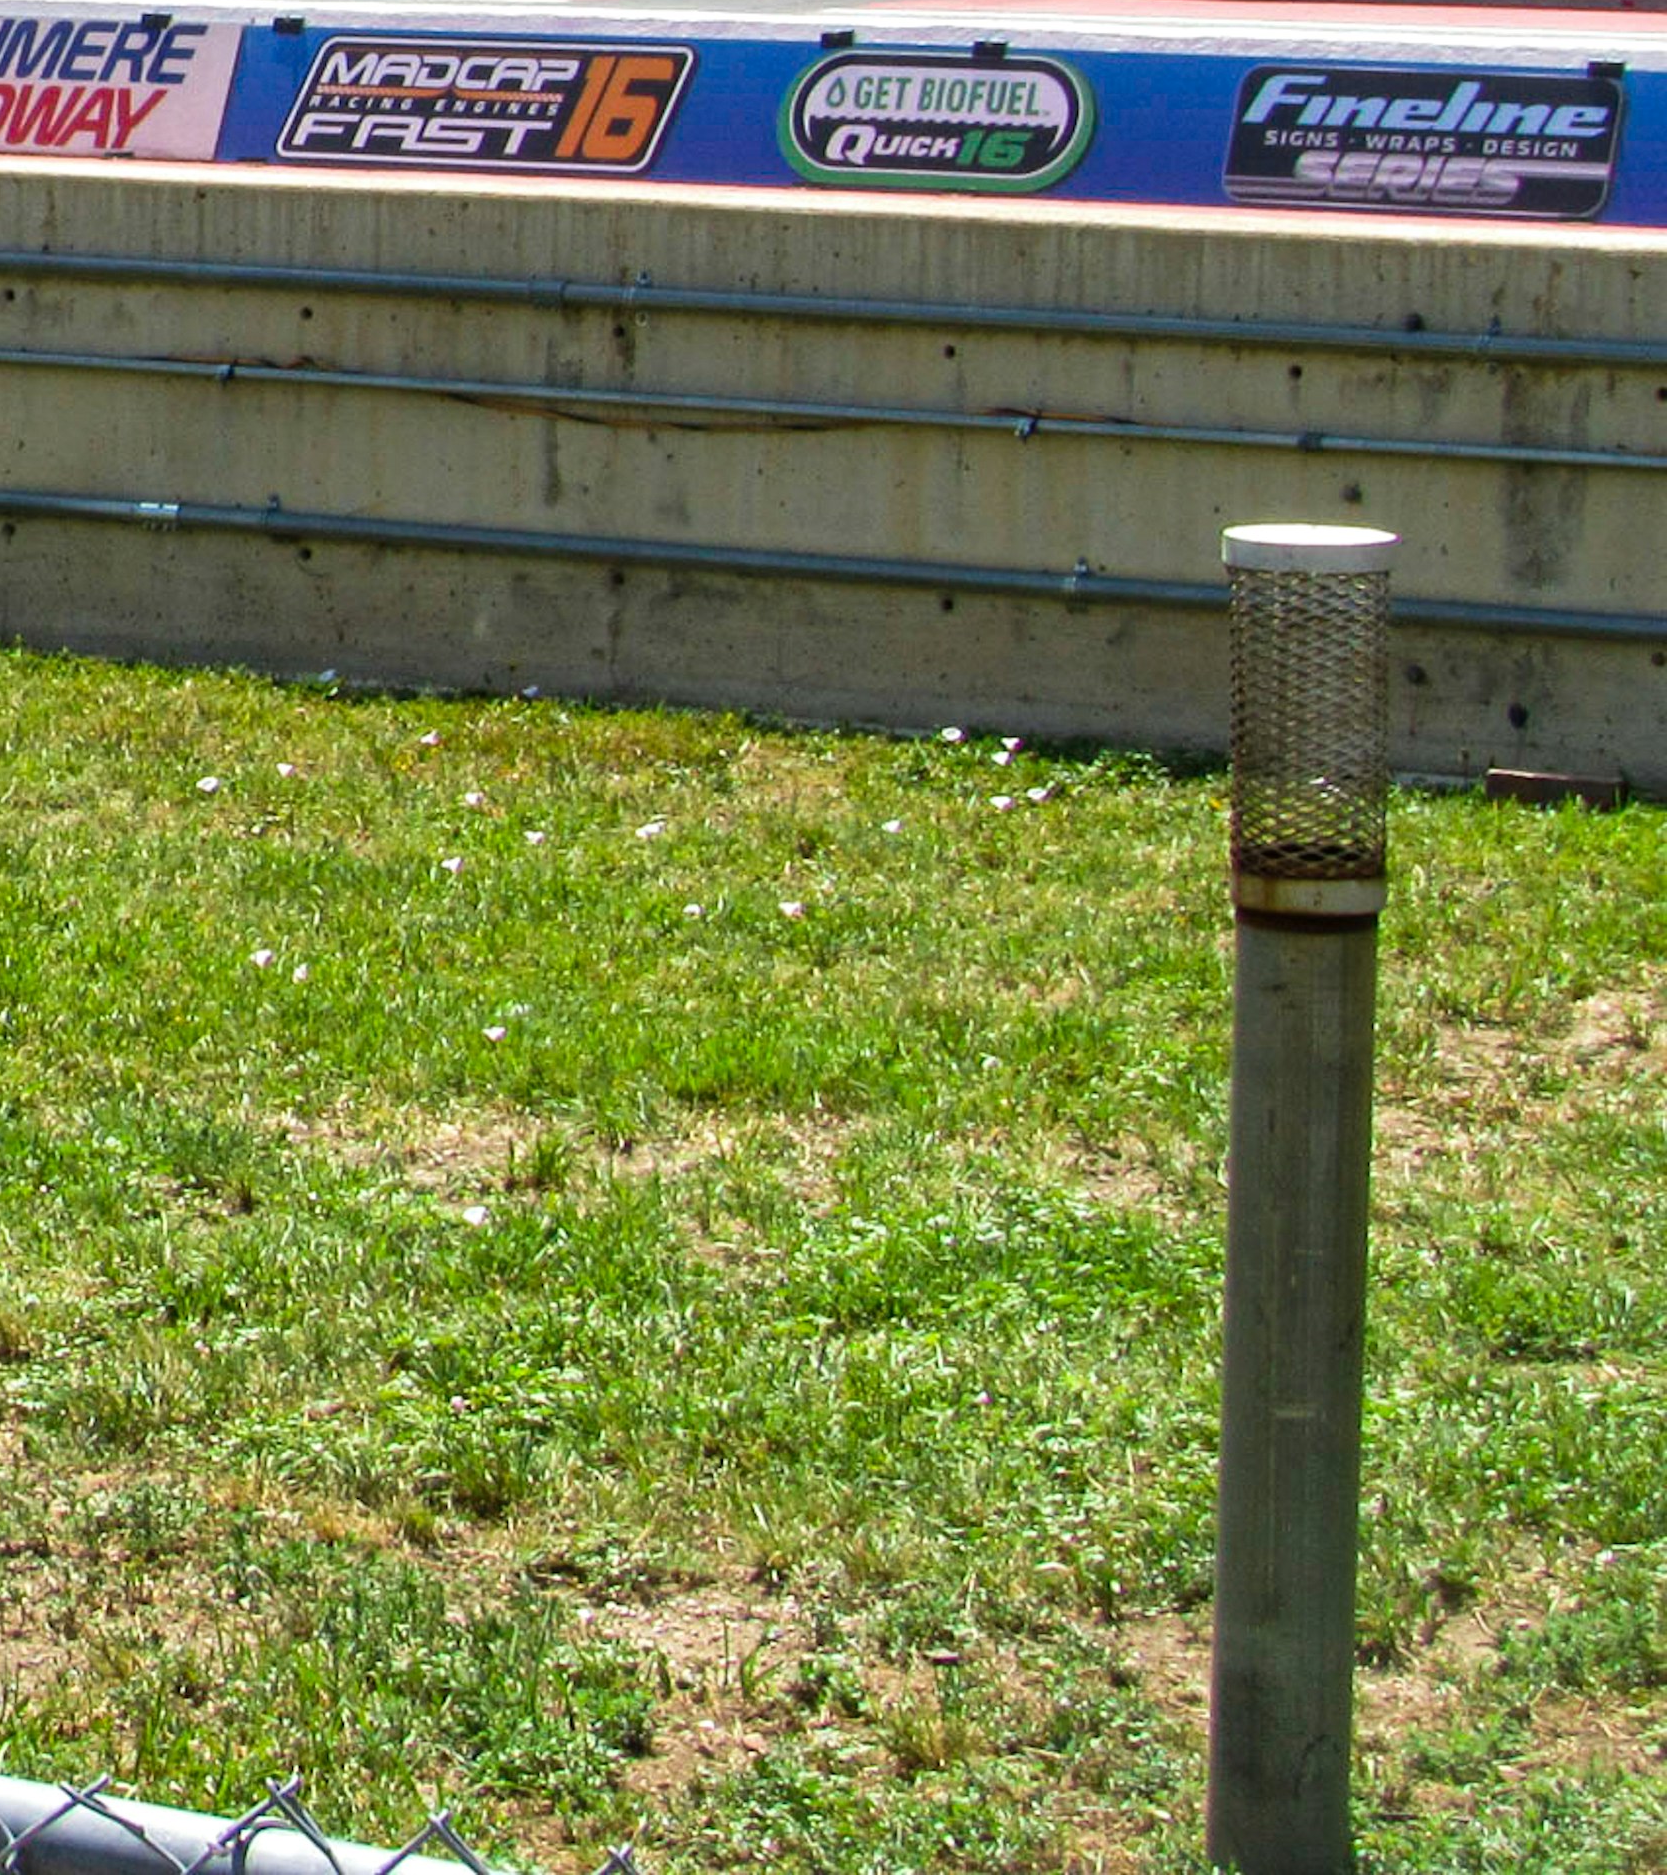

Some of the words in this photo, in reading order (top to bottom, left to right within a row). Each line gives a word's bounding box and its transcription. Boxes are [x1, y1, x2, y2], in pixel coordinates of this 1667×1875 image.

[309, 96, 412, 111] RACING
[435, 100, 559, 116] ENGINES
[322, 51, 579, 91] MADCAP
[555, 55, 674, 160] 16
[854, 76, 912, 109] GET
[919, 78, 1040, 116] BIOFUEL
[1242, 73, 1608, 138] Fineline
[291, 113, 553, 156] FAST
[956, 129, 1034, 168] 16
[1264, 129, 1339, 149] SIGNS
[1366, 133, 1456, 154] WRAPS
[1483, 139, 1579, 158] DESIGN
[1294, 149, 1520, 206] SERIES
